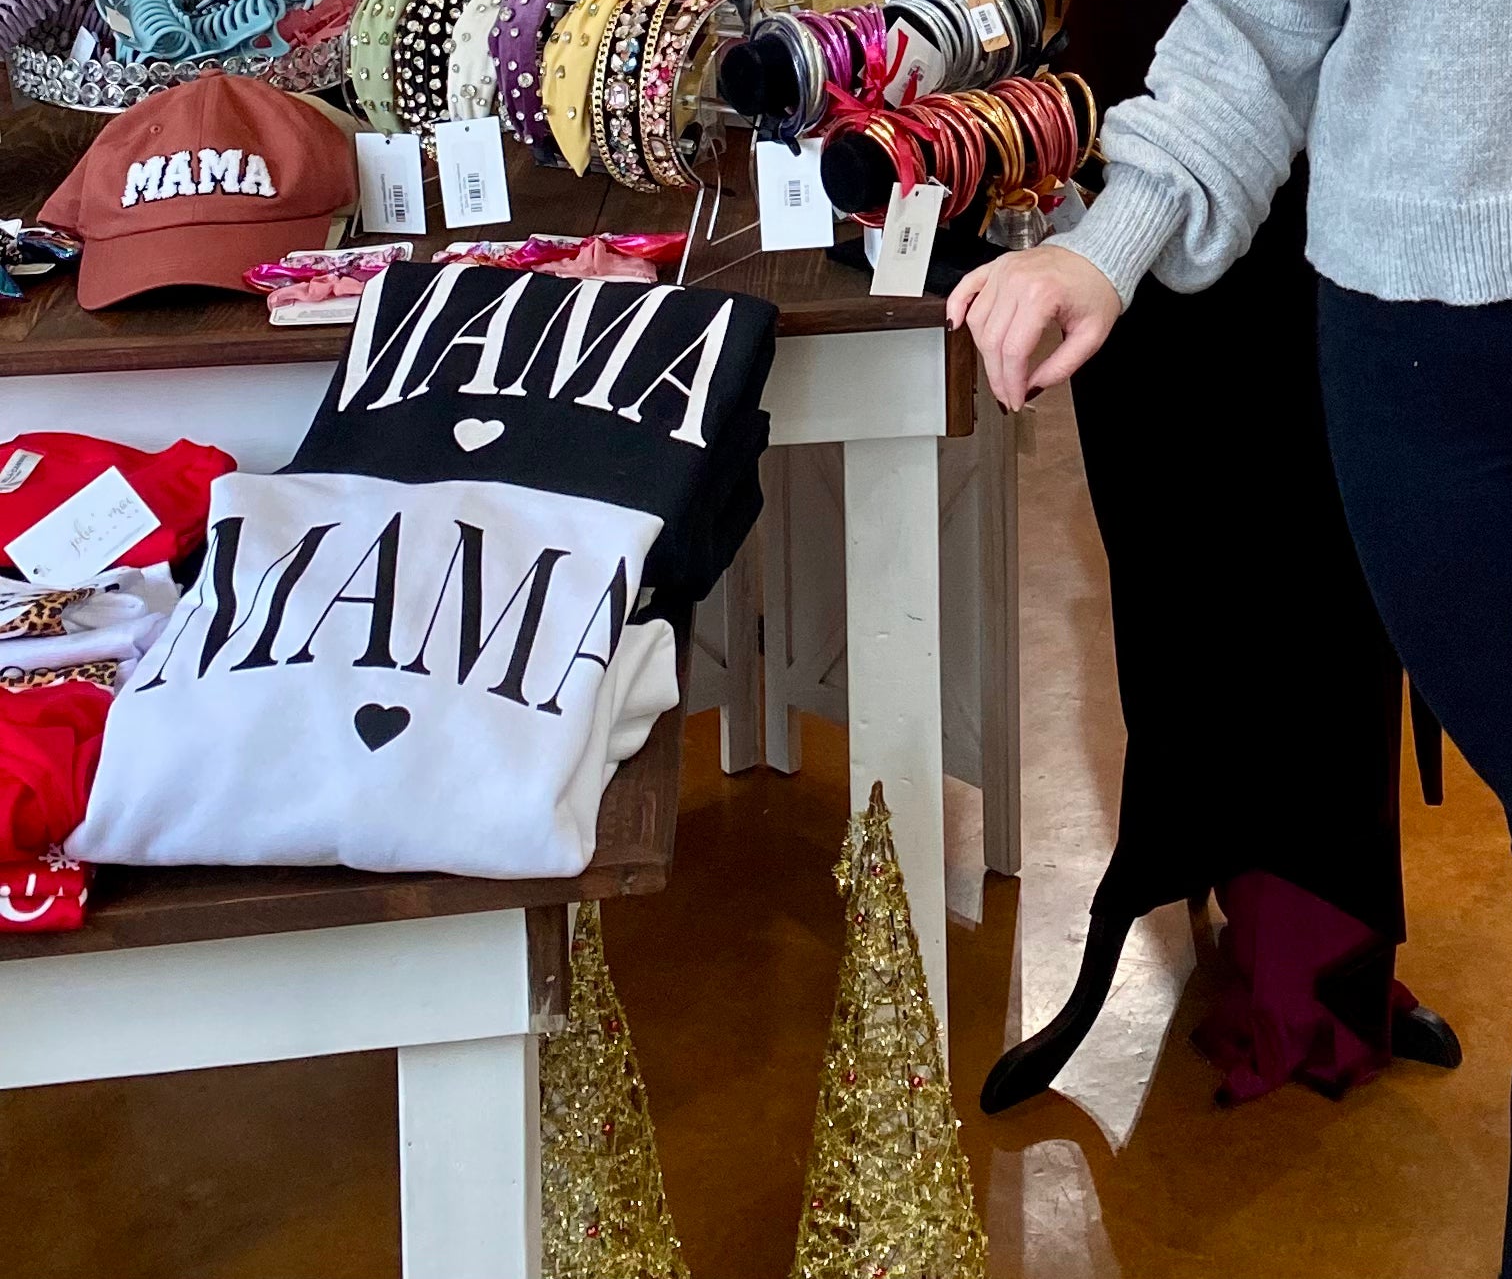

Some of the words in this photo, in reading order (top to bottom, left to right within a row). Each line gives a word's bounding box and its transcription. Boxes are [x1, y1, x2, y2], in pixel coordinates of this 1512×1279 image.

[120, 147, 277, 208] MAMA
[337, 263, 734, 448] MAMA
[135, 511, 628, 716] MAMA
